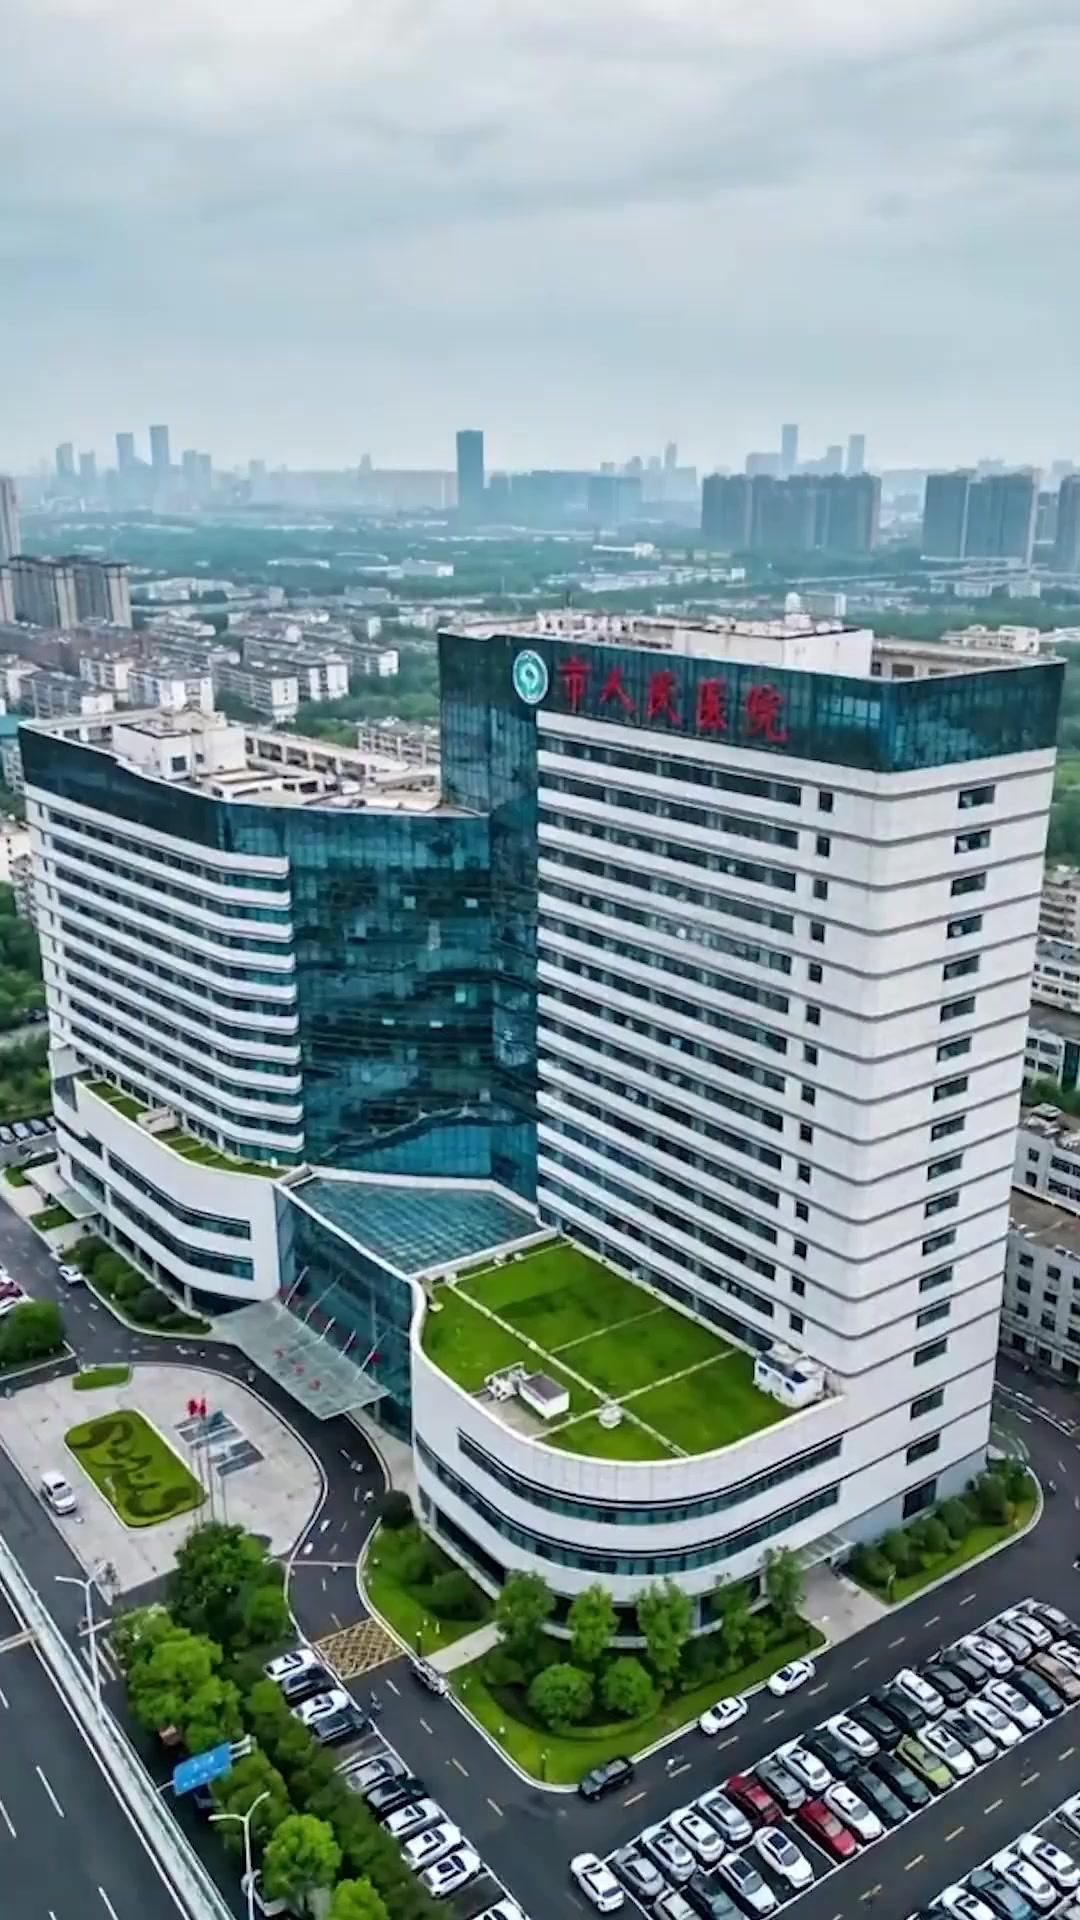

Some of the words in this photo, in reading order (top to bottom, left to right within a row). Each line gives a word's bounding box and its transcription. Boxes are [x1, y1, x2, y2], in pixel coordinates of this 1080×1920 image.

[558, 656, 788, 741] 市人民医院
